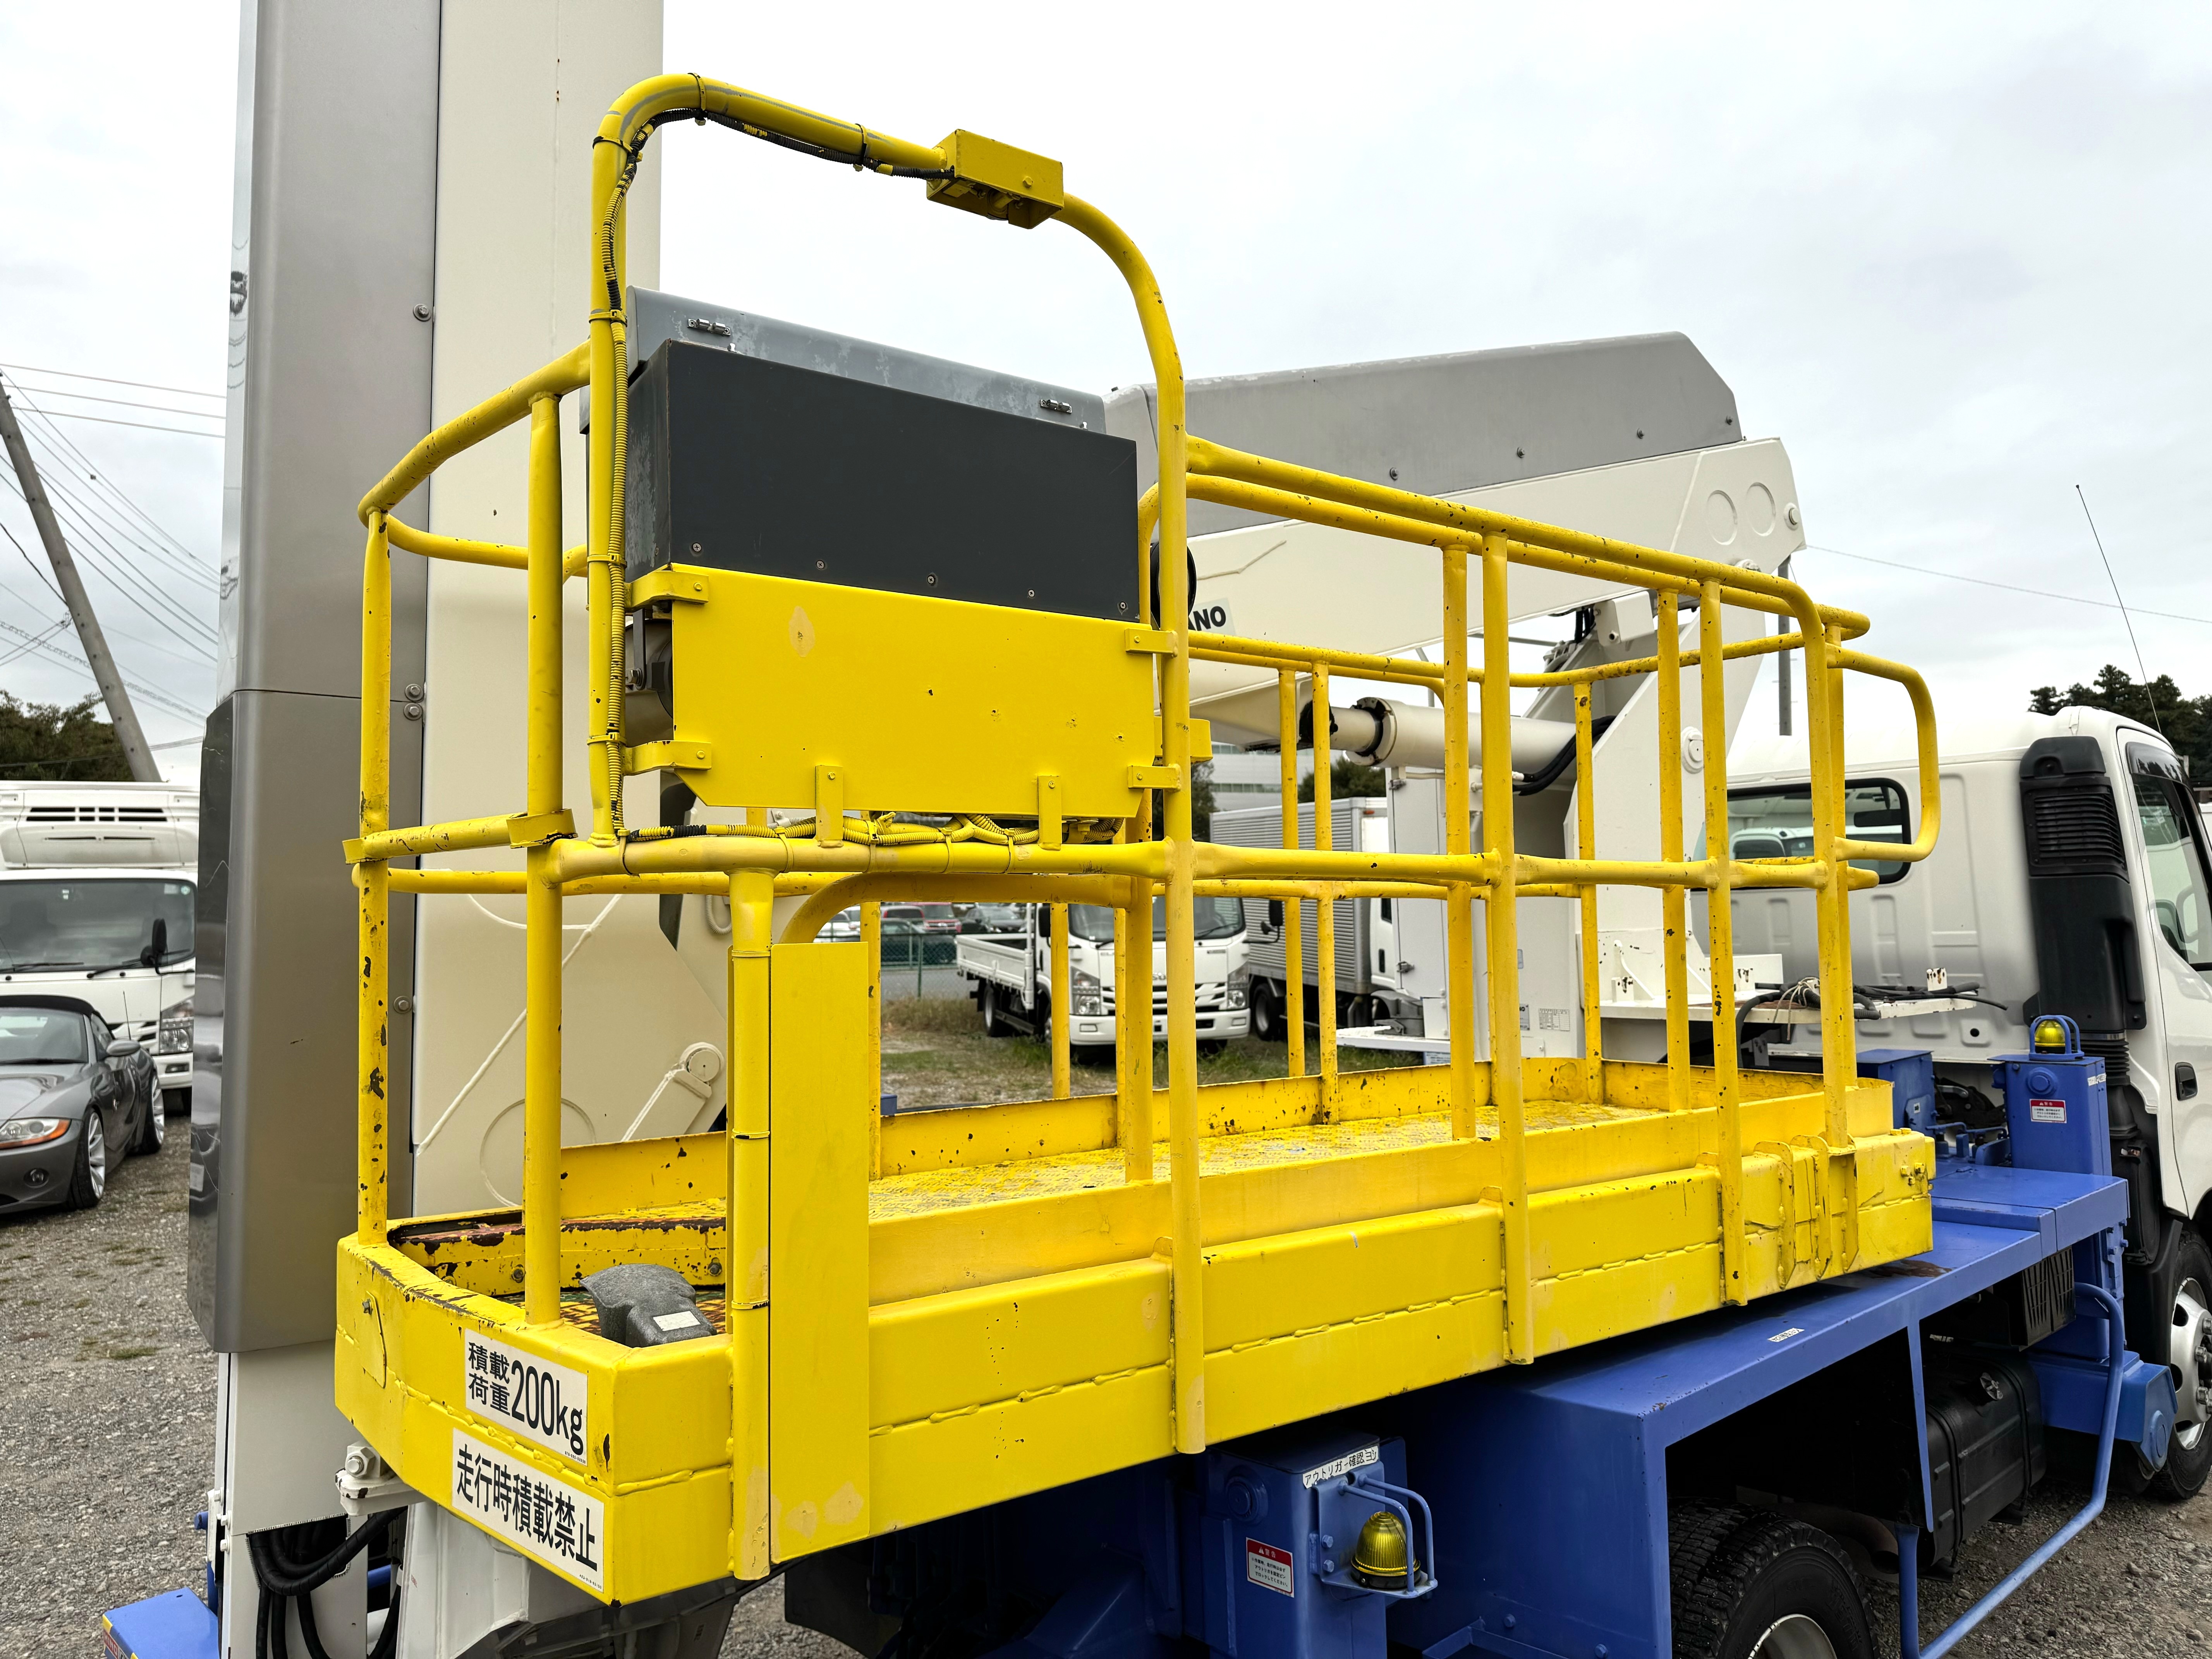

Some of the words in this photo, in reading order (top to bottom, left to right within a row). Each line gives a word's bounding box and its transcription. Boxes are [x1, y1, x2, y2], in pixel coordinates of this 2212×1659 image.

[469, 1342, 510, 1384] 積載
[469, 1373, 510, 1416] 荷重
[511, 1360, 584, 1455] 200kg
[457, 1444, 597, 1571] 走行時積載禁止
